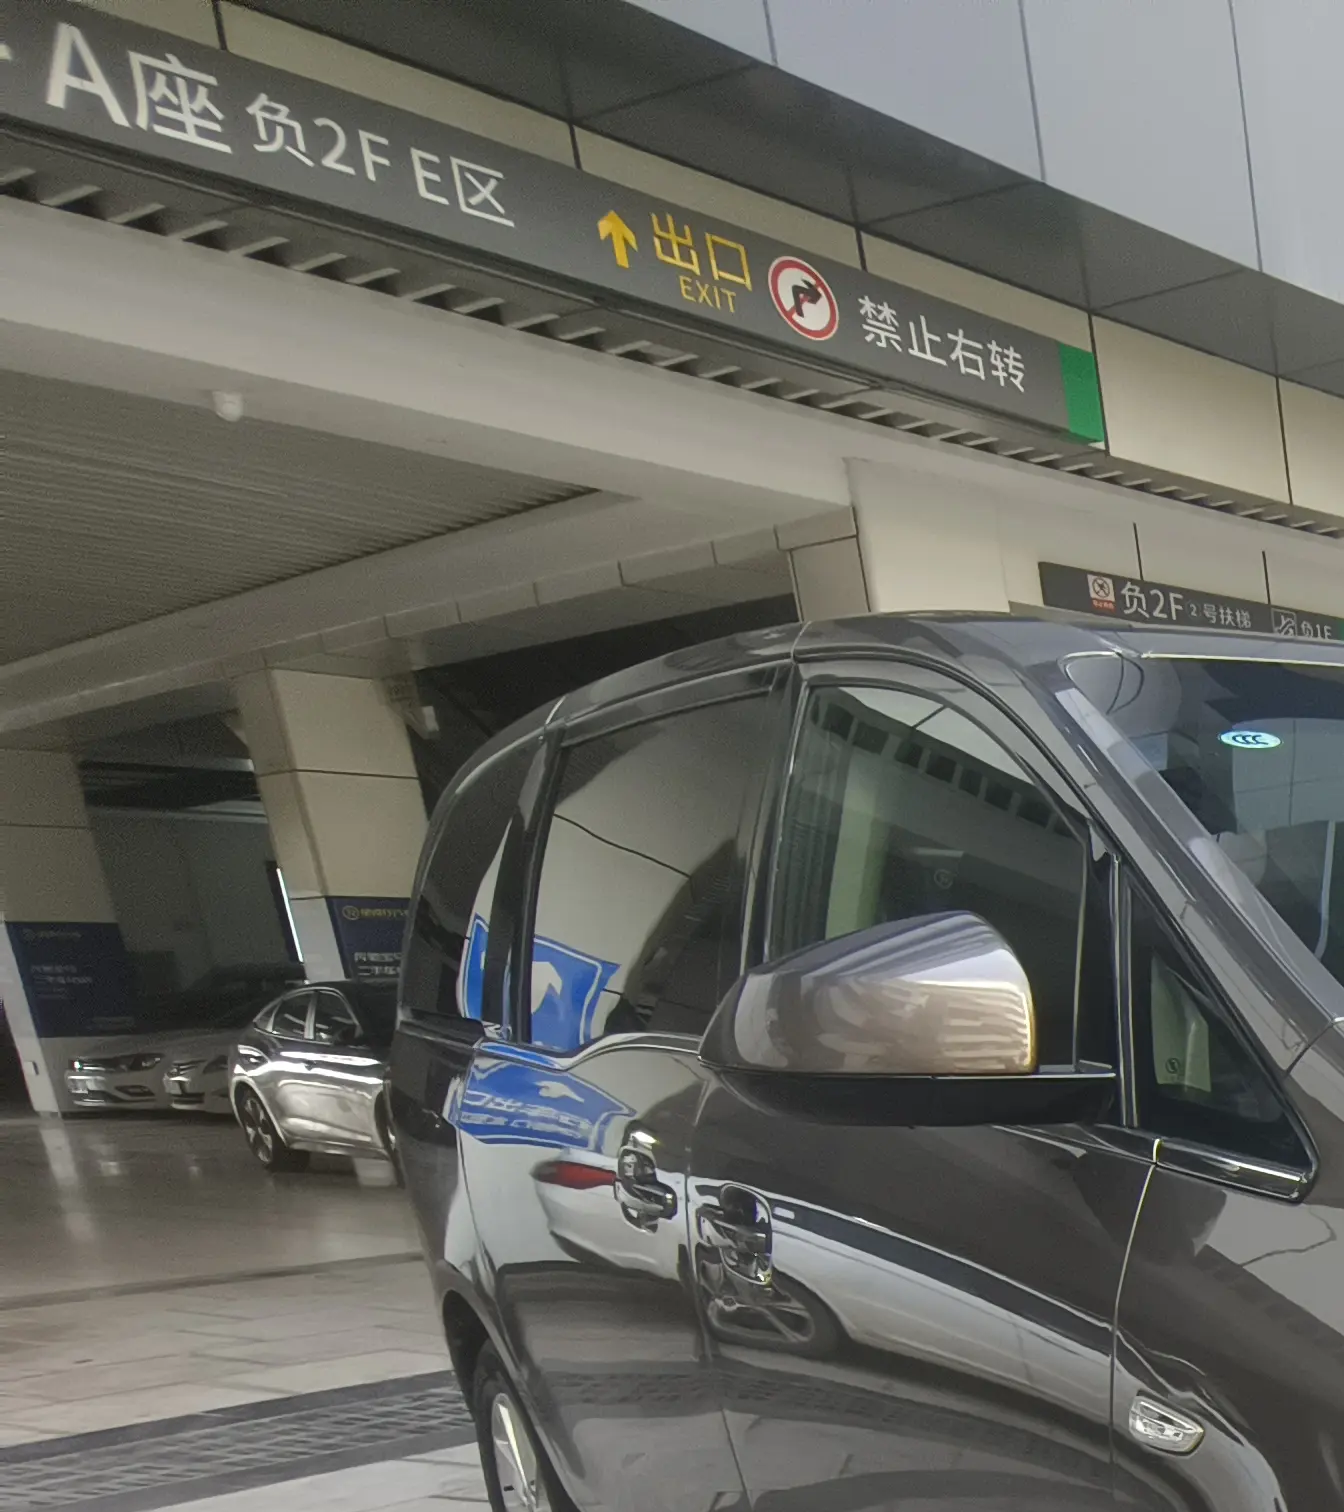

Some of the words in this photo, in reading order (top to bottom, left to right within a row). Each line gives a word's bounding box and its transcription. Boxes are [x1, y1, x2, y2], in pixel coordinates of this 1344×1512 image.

[46, 21, 232, 154] A座
[247, 92, 391, 182] 负2F
[410, 146, 515, 227] E区
[651, 212, 753, 292] 出口
[680, 276, 737, 313] EXIT
[858, 295, 1026, 393] 禁止右转
[1120, 581, 1185, 620] 负2F
